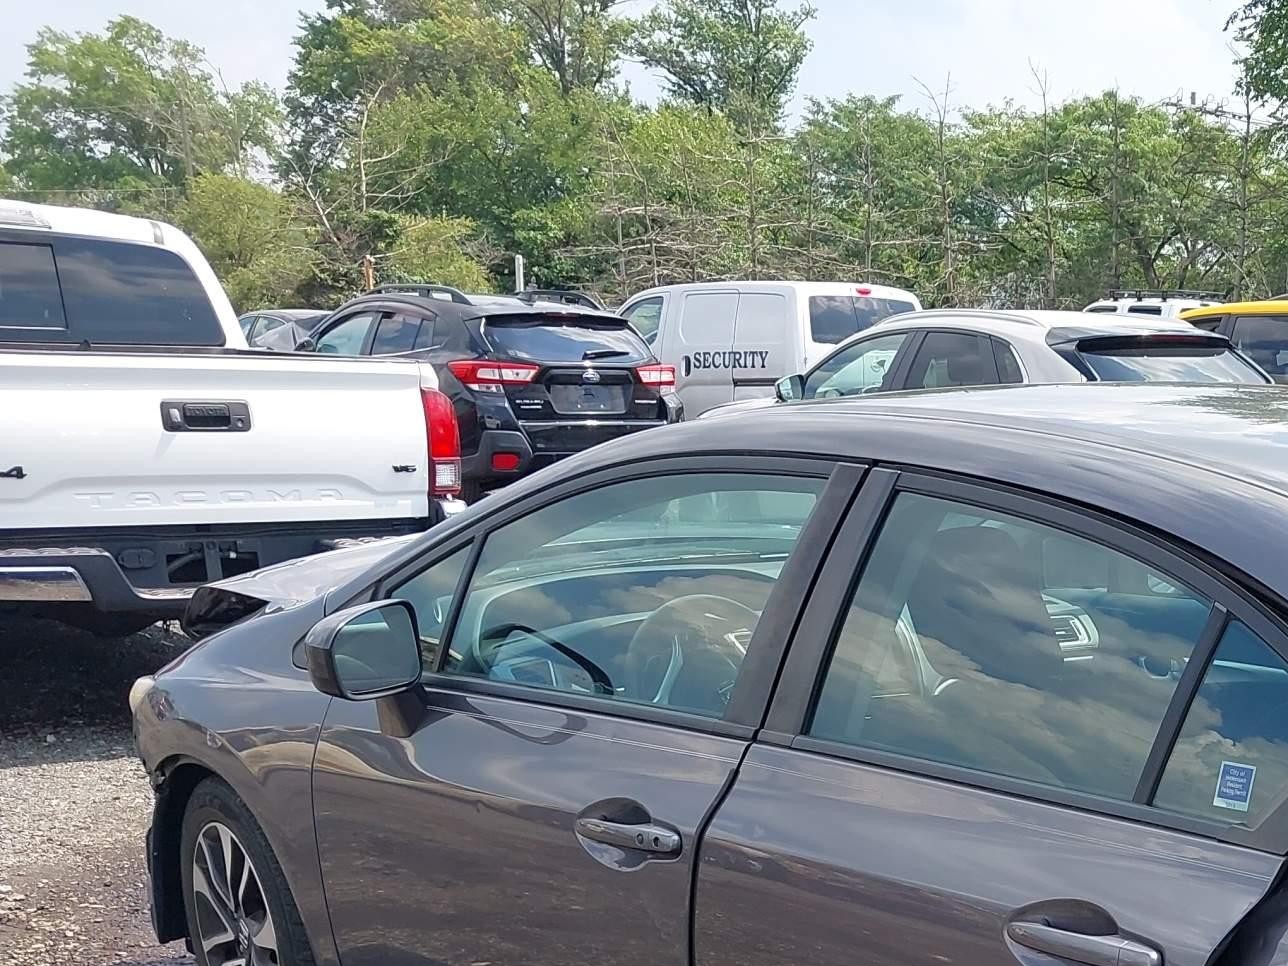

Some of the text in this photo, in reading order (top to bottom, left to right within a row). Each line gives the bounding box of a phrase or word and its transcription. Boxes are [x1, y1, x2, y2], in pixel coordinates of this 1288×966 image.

[693, 350, 769, 369] SECURITY
[0, 466, 28, 479] 4
[392, 465, 417, 473] V6
[72, 488, 344, 509] TACOMA
